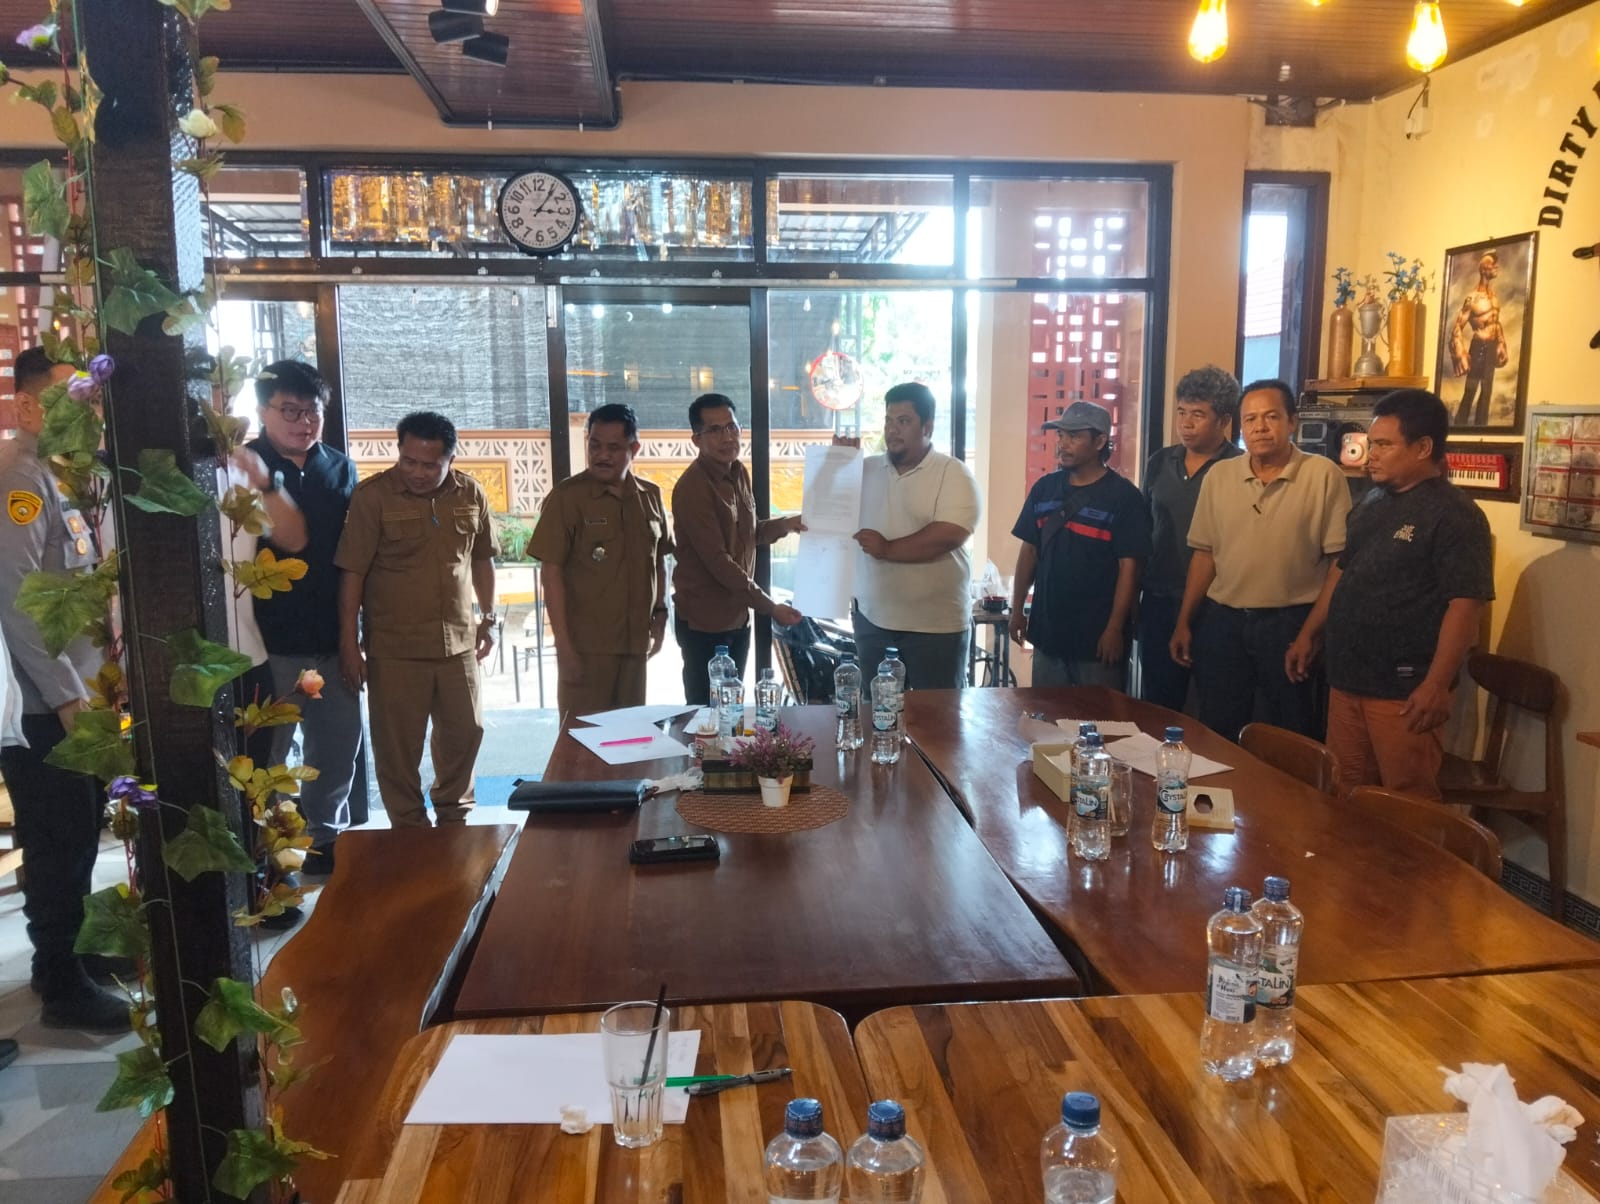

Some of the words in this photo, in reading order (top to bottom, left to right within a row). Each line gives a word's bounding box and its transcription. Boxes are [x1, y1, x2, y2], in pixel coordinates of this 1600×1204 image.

[1537, 106, 1599, 228] DIRTY
[519, 181, 532, 196] 11
[533, 178, 546, 192] 12
[509, 189, 525, 205] 10
[553, 192, 567, 205] 2
[558, 207, 571, 216] 3
[511, 217, 524, 229] 8
[555, 218, 568, 229] 4
[523, 226, 533, 239] 7
[535, 230, 545, 243] 6
[546, 227, 558, 240] 5
